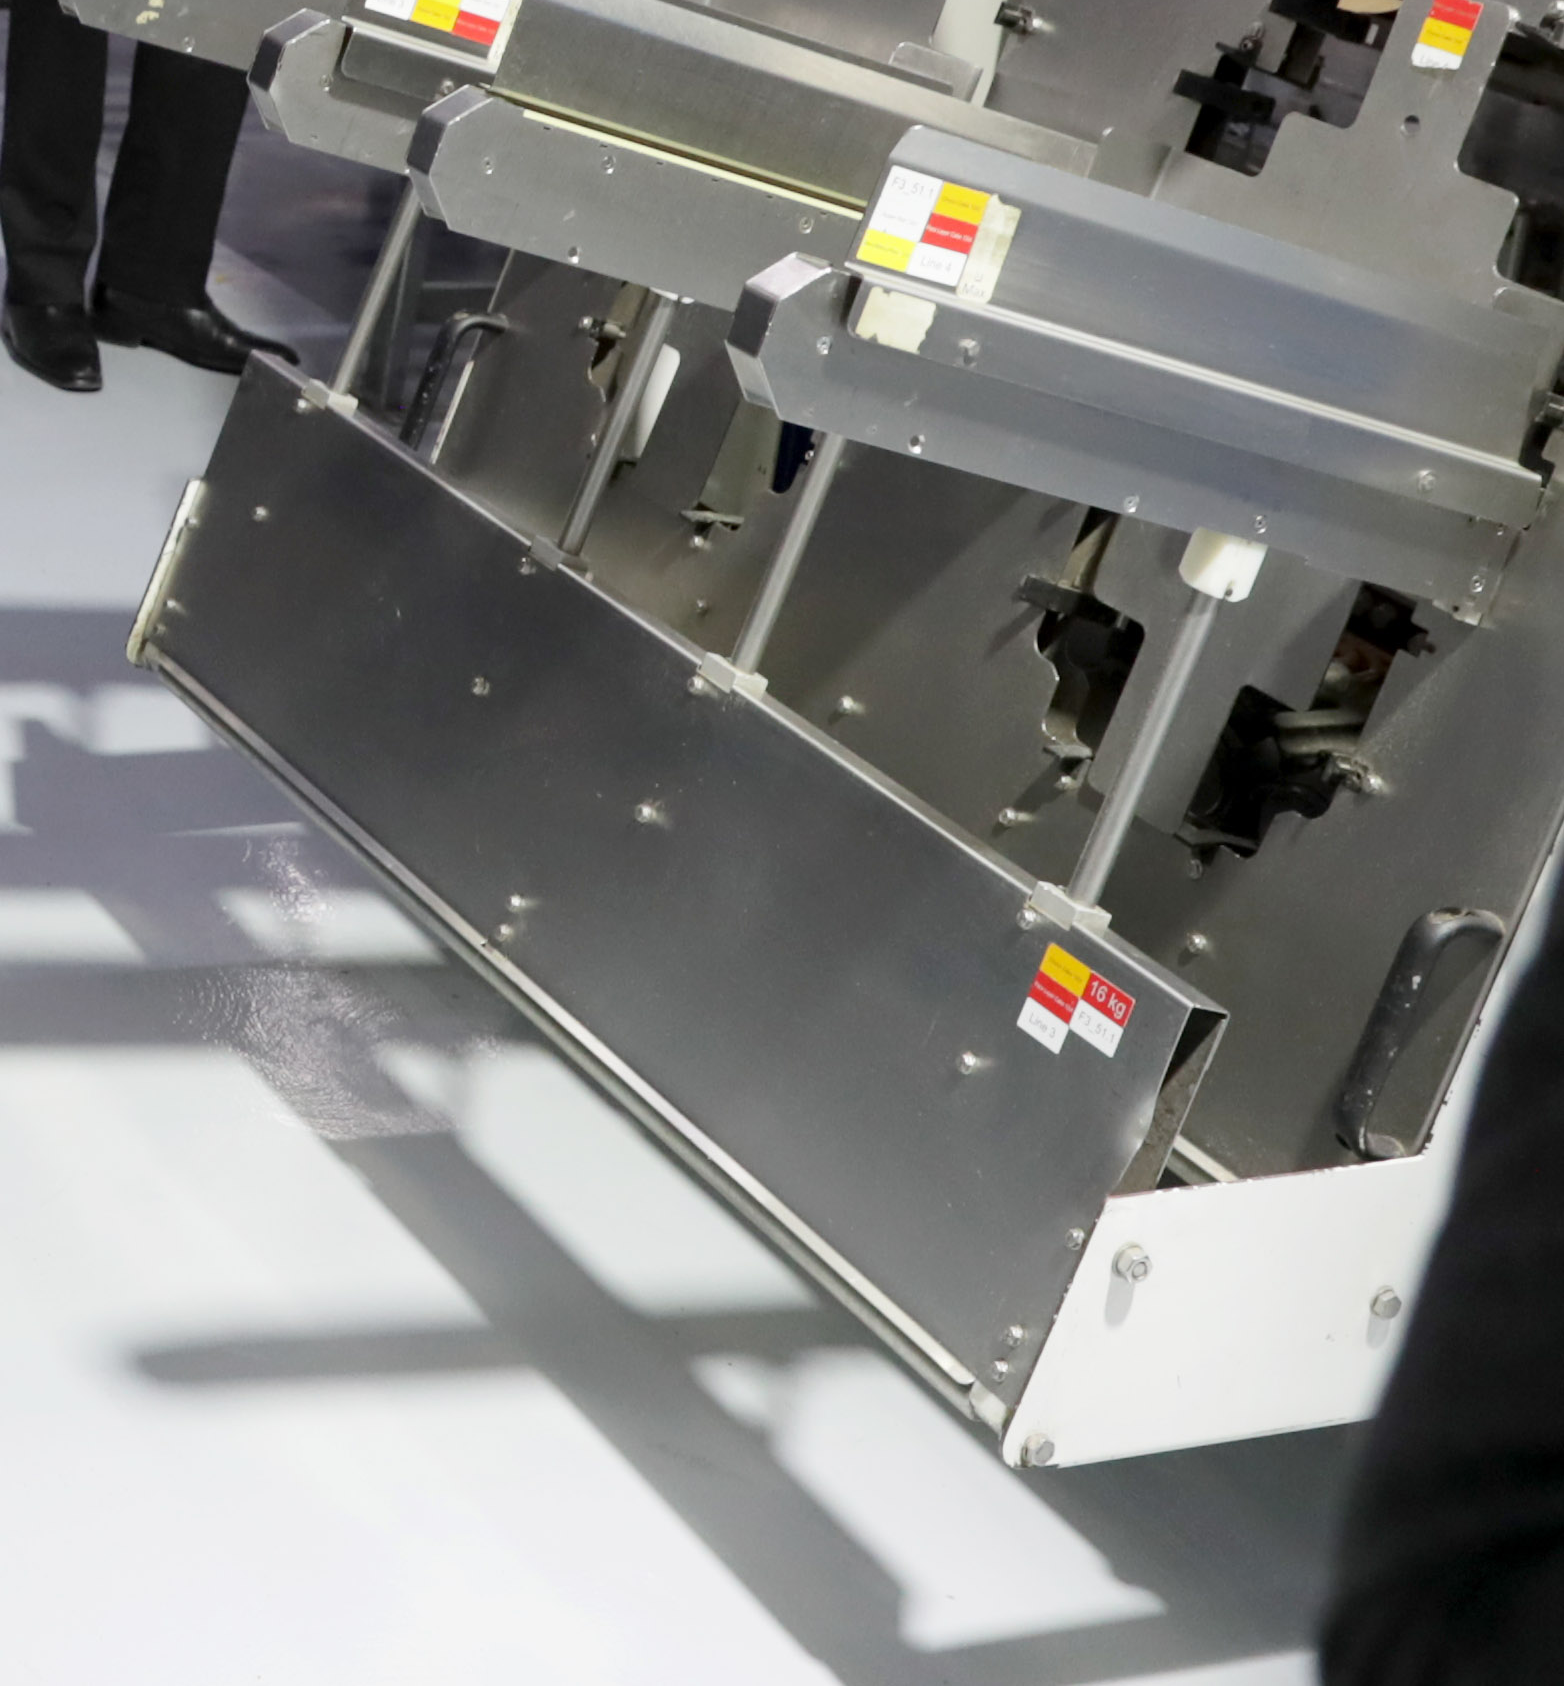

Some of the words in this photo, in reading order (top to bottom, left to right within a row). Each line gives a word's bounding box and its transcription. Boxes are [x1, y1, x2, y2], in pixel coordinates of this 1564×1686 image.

[920, 256, 943, 270] Line
[1089, 980, 1108, 1003] 16
[1107, 992, 1127, 1020] kg
[1029, 1011, 1048, 1033] Line
[1049, 1026, 1056, 1039] 3
